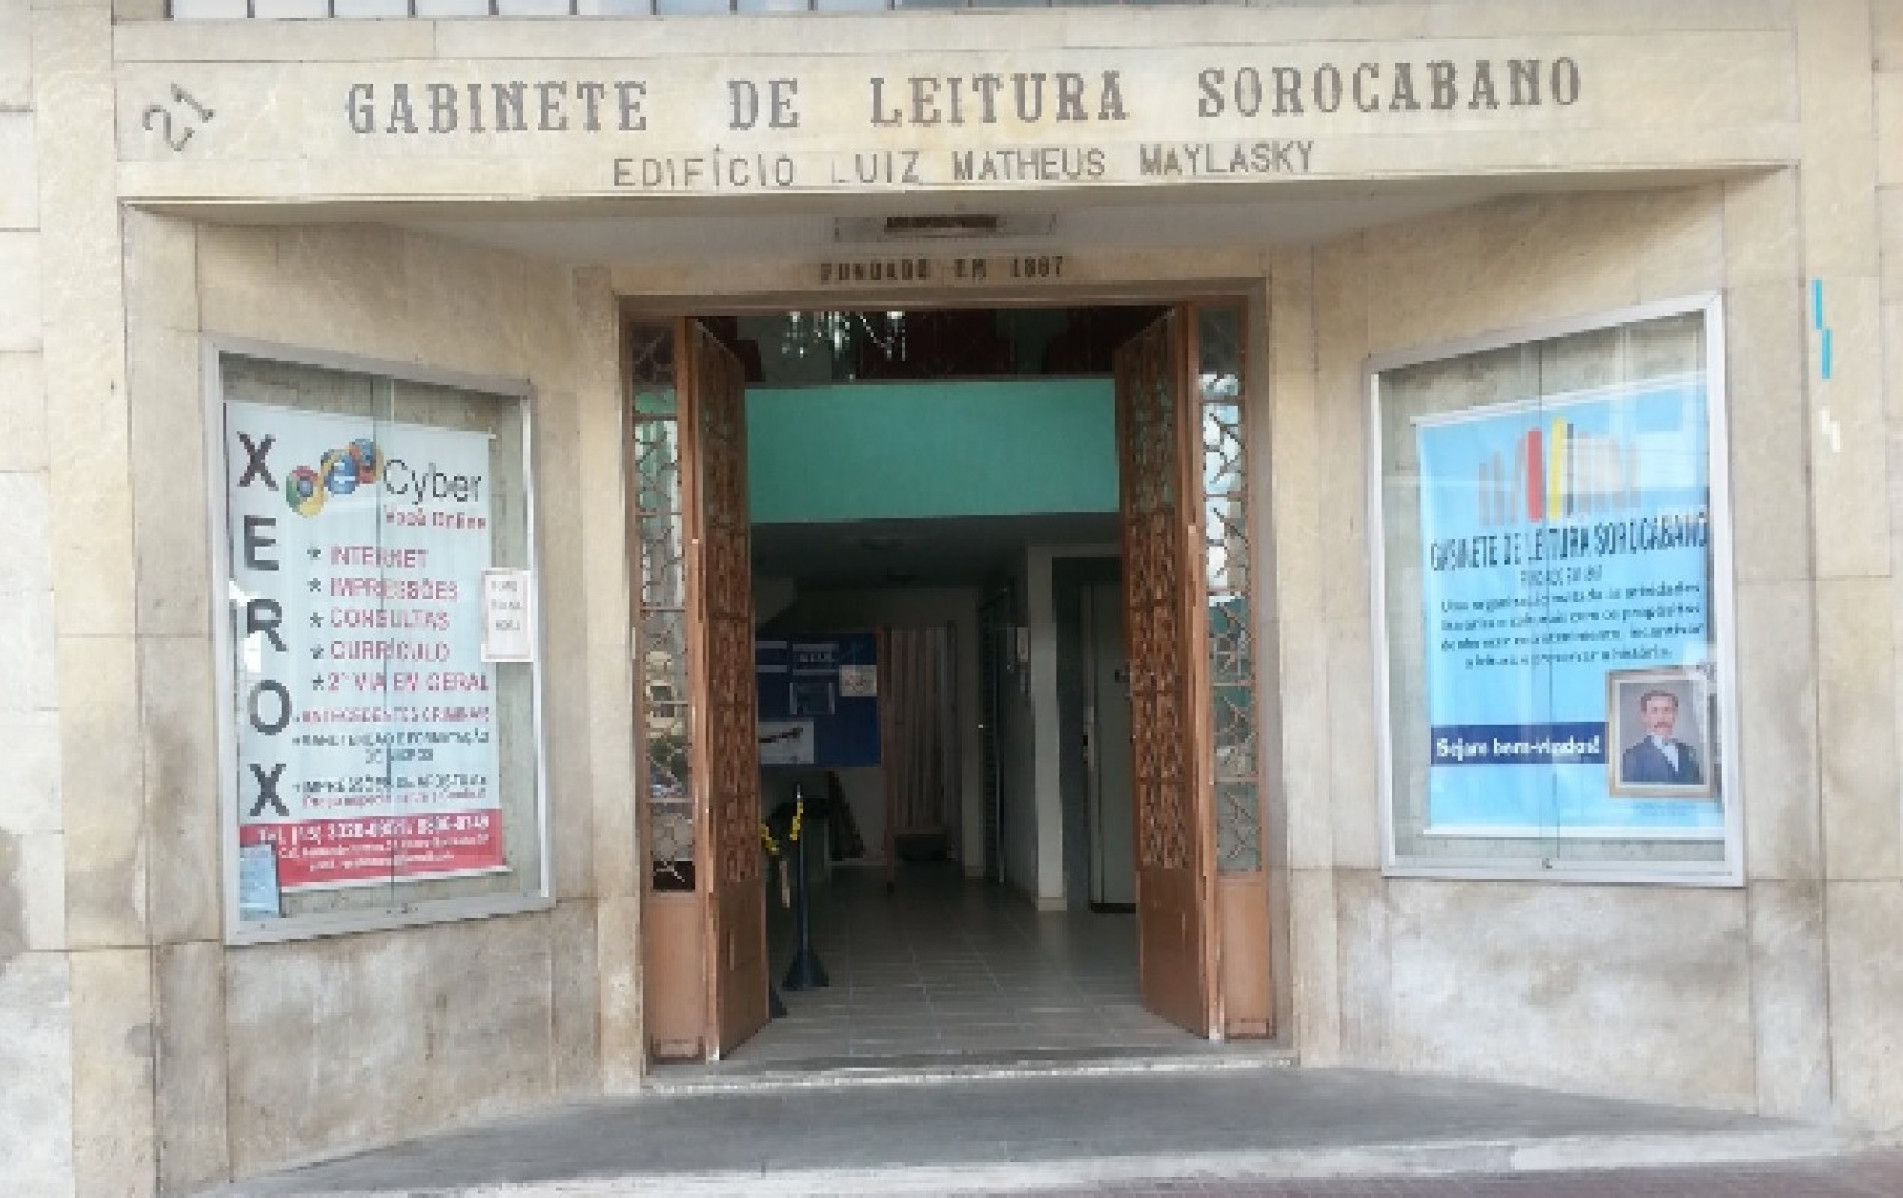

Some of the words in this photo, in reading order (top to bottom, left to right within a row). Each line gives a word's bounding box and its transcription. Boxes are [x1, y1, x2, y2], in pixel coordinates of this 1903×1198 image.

[346, 81, 647, 134] GABINETE
[728, 77, 799, 130] DE
[870, 70, 1130, 126] LEITURA
[1199, 57, 1580, 117] SOROCABANO
[613, 144, 795, 187] EDIFÍCIO
[832, 149, 923, 186] LUIZ
[952, 147, 1106, 182] MATHEUS
[1139, 140, 1314, 176] MAYLASKY
[820, 258, 928, 284] FUNDADO
[954, 258, 987, 279] EM
[383, 459, 482, 505] Cyber
[1528, 525, 1589, 561] LEITURA
[1594, 512, 1708, 555] SOROCABANO
[330, 546, 429, 569] INTERNET
[330, 577, 458, 600] IMPRESSÕES
[236, 431, 292, 817] XEROX
[330, 608, 450, 631] CONSULTAS
[330, 638, 450, 662] CURRÍCULO
[393, 672, 419, 692] EM
[425, 672, 490, 692] GERAL
[1436, 737, 1487, 762] Sejam
